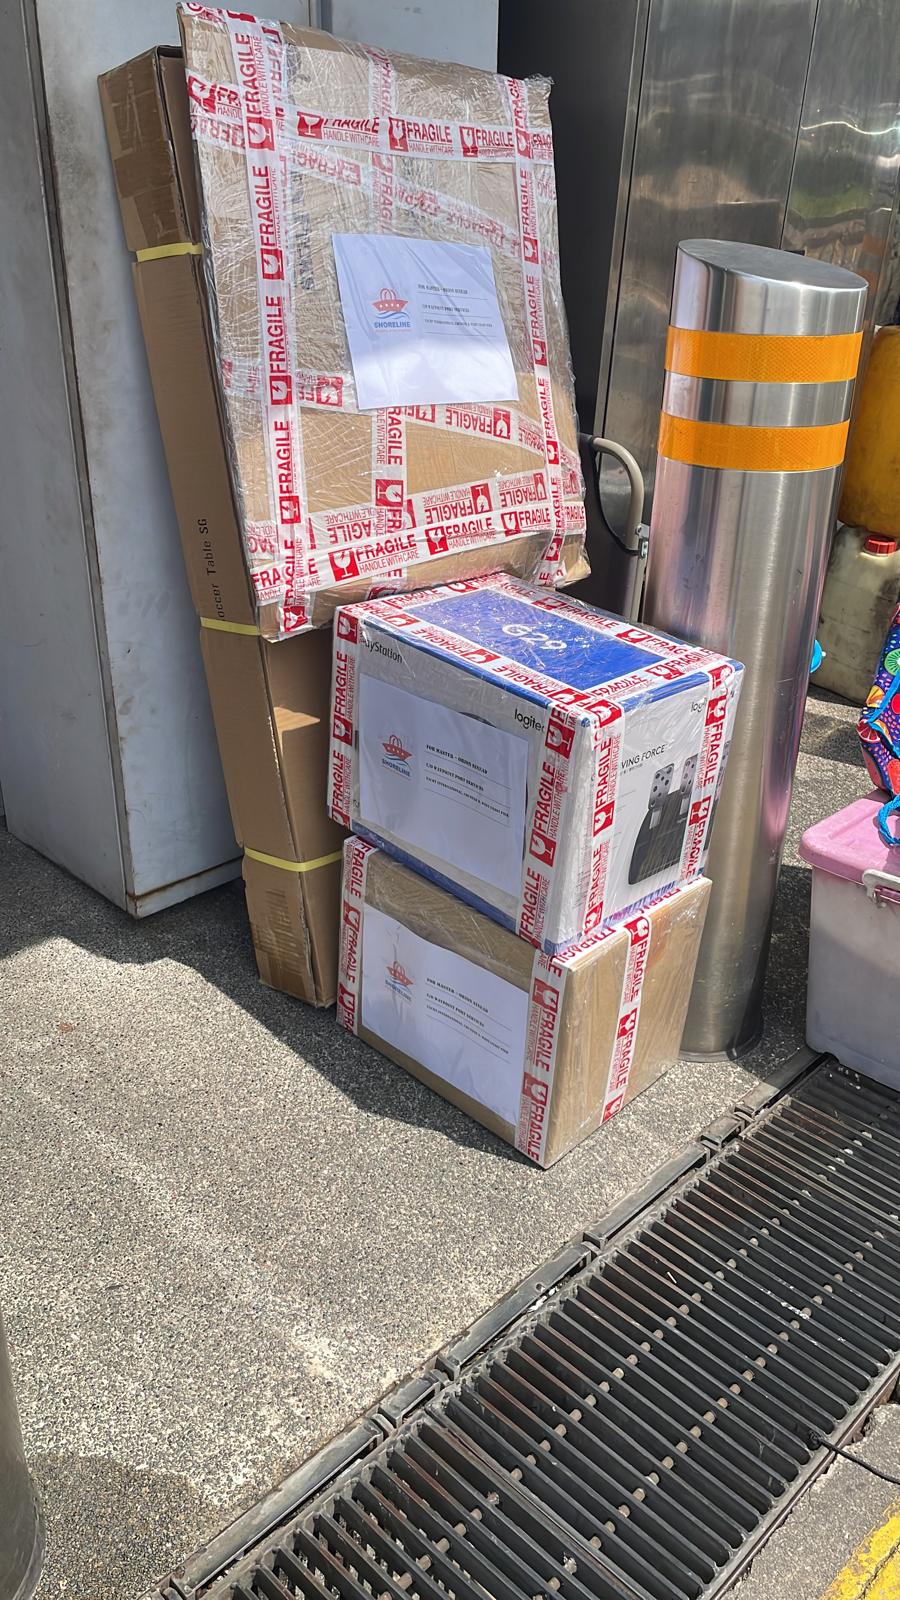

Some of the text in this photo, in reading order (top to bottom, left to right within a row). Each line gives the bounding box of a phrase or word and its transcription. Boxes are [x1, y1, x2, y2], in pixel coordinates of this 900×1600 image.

[236, 33, 262, 114] FRAGILE
[407, 122, 453, 143] FRAGILE
[476, 129, 515, 148] FRAGILE
[253, 165, 276, 247] FRAGILE
[519, 168, 531, 237] FRAGILE
[265, 296, 286, 374] FRAGILE
[526, 275, 540, 339] FRAGILE
[388, 406, 403, 465] RAGILE
[445, 408, 493, 435] FRAGILE
[537, 377, 553, 439] FRAGILE
[274, 420, 295, 494] FRAGILE
[424, 500, 474, 525] FRAGILE
[500, 486, 538, 508] FRAGILE
[519, 508, 551, 528] FRAGILE
[551, 477, 562, 537] FRAGILE
[327, 520, 372, 545] AGILE
[356, 534, 417, 562] FRAGILE
[446, 516, 493, 538] FRAGILE
[202, 541, 217, 577] Table
[211, 584, 225, 618] occer
[501, 582, 536, 598] AGILE
[561, 604, 620, 629] FRAGILE
[411, 628, 463, 653] FRAGILE
[501, 623, 568, 650] G29
[334, 650, 348, 717] FRAGILE
[491, 664, 550, 698] FRAGILE
[514, 708, 545, 732] logitec
[332, 750, 344, 809] FRAGILE
[381, 758, 410, 777] SHORELINE
[594, 737, 612, 809] FRAGILE
[620, 744, 666, 769] VING FORCE
[703, 722, 724, 787] FRAGILE
[534, 762, 556, 834] FRAGILE
[350, 842, 372, 899] FRAGILE
[588, 848, 602, 908] FRAGILE
[686, 820, 705, 880] FRAGILE
[519, 867, 541, 935] FRAGILE
[345, 928, 359, 984] FRAGILE
[631, 941, 648, 1002] FRAGILE
[536, 1008, 557, 1073] FRAGILE
[616, 1031, 634, 1089] FRAGILE
[527, 1101, 545, 1162] FRAGILE
